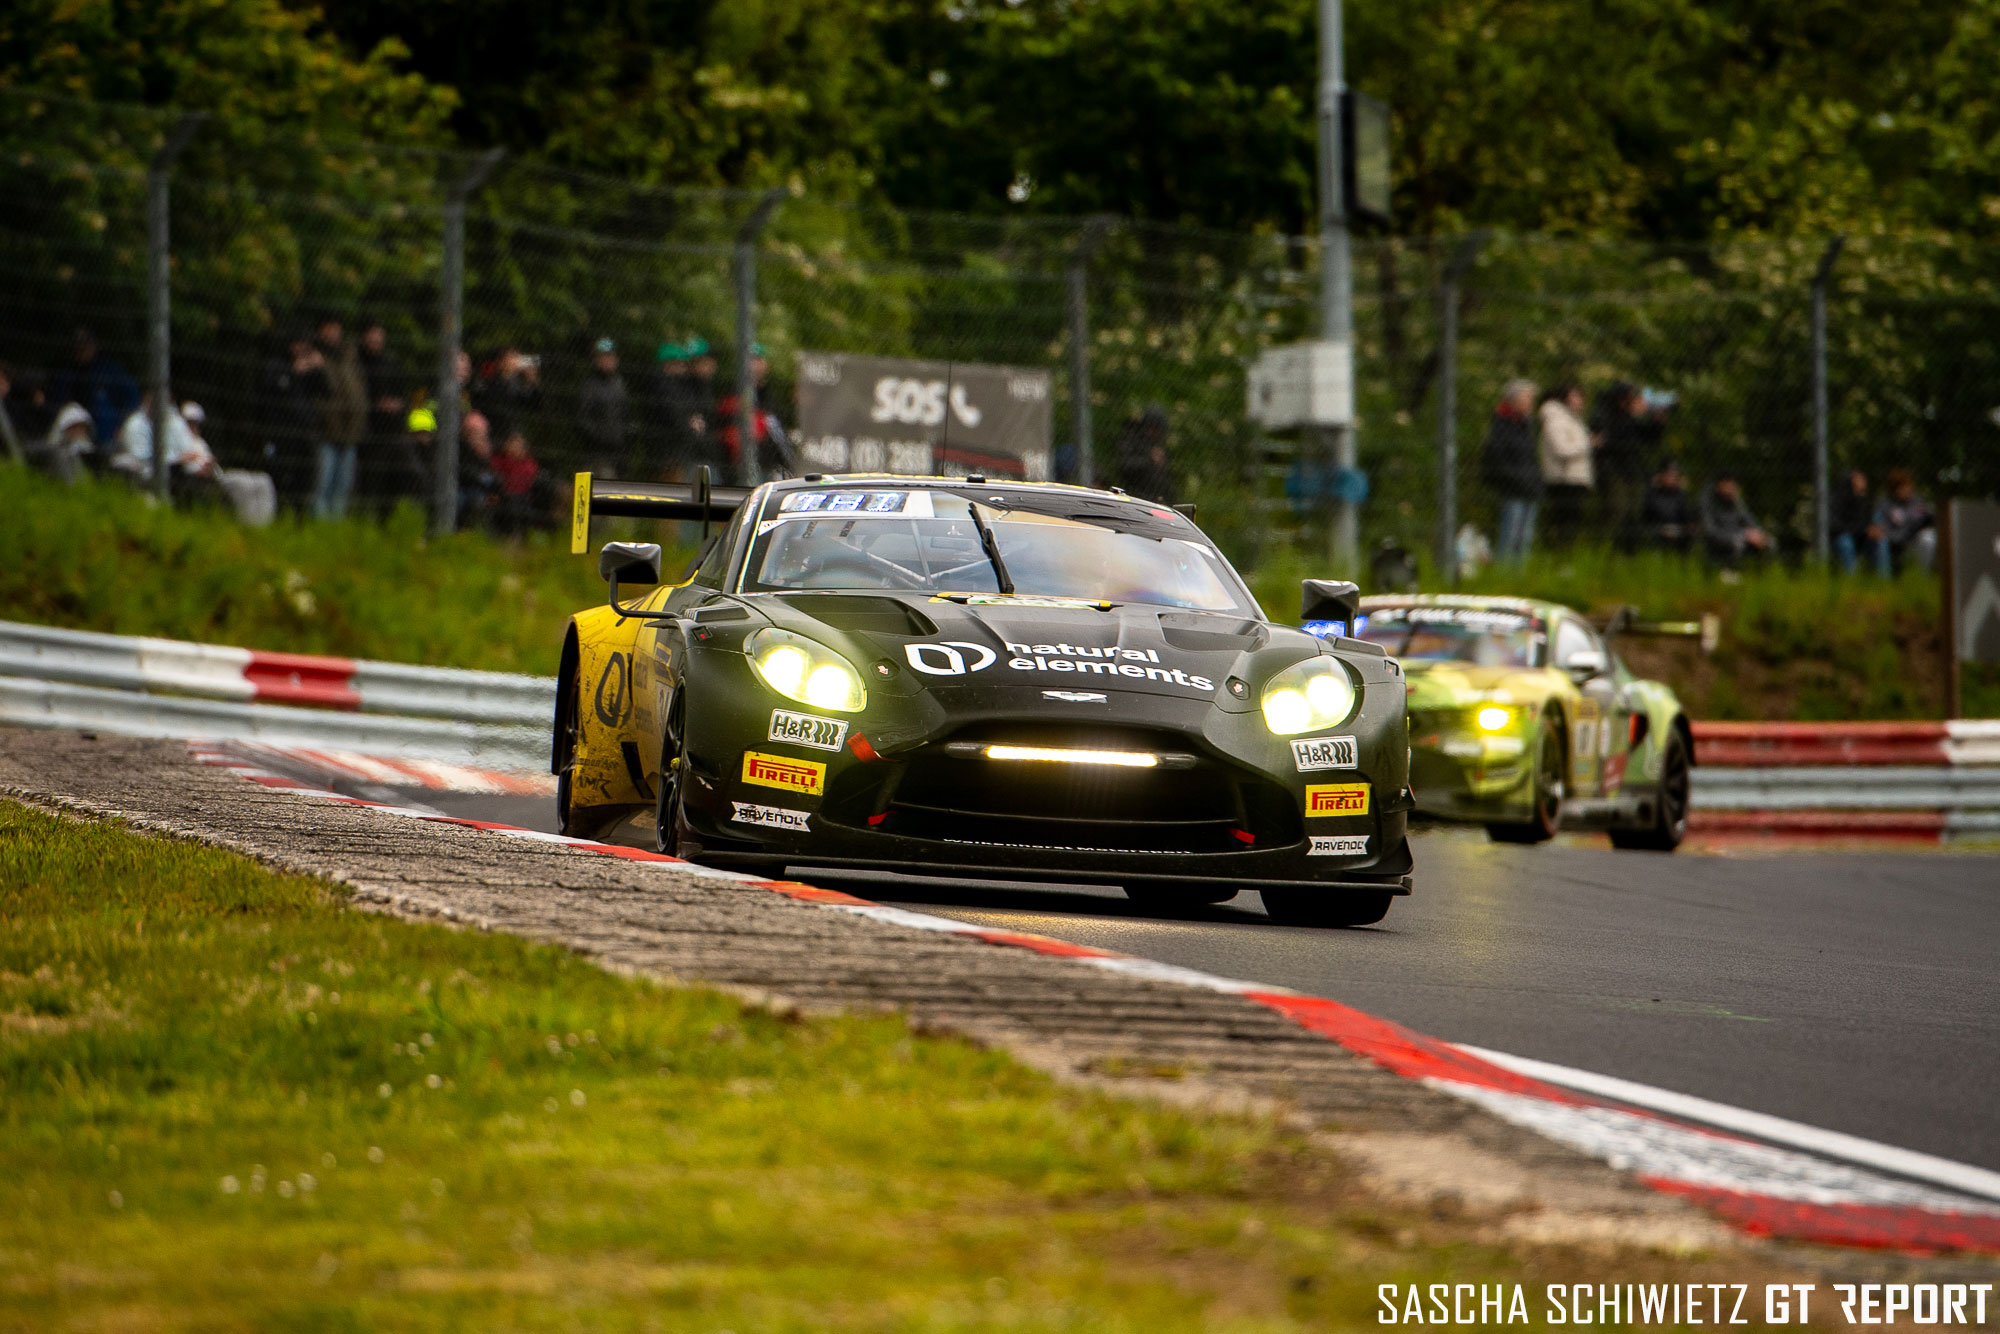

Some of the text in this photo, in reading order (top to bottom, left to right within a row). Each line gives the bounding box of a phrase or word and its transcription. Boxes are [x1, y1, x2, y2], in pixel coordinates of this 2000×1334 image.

[870, 376, 948, 427] SOS
[1005, 641, 1160, 664] natural
[1008, 656, 1215, 692] elements
[773, 713, 813, 740] H&R
[1295, 742, 1333, 764] H&R
[749, 758, 818, 788] PIRELLI
[1311, 791, 1365, 811] PIRELLI
[739, 808, 804, 826] RAVENOL
[1315, 840, 1364, 851] RAVENOL
